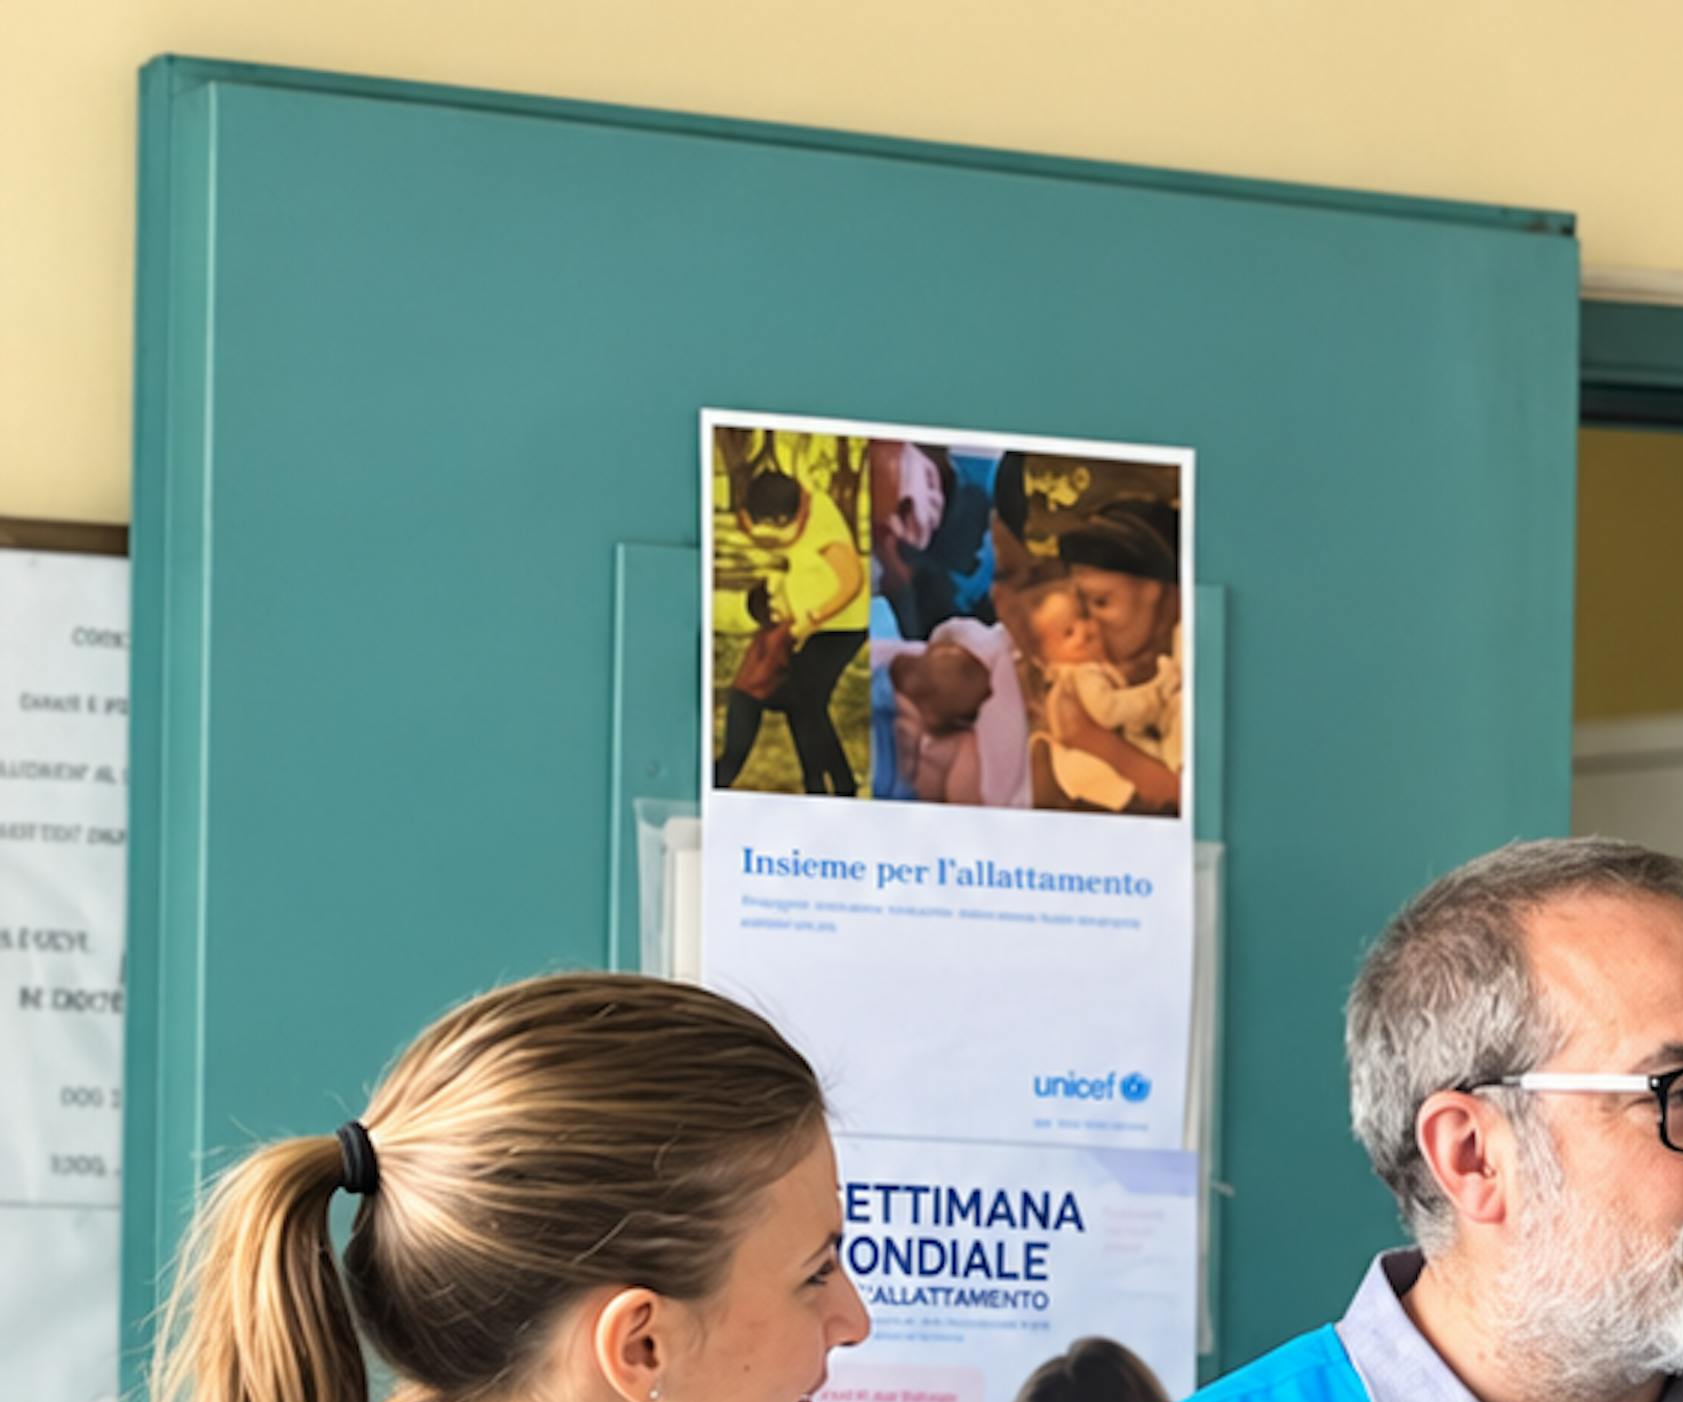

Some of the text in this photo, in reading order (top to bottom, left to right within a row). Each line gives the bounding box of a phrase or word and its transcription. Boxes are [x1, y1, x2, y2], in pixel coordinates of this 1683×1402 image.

[740, 846, 1153, 898] Insieme per l'allattamento
[1033, 1071, 1117, 1102] unicef
[837, 1182, 1086, 1233] ETTIMANA
[835, 1234, 1049, 1281] ONDIALE
